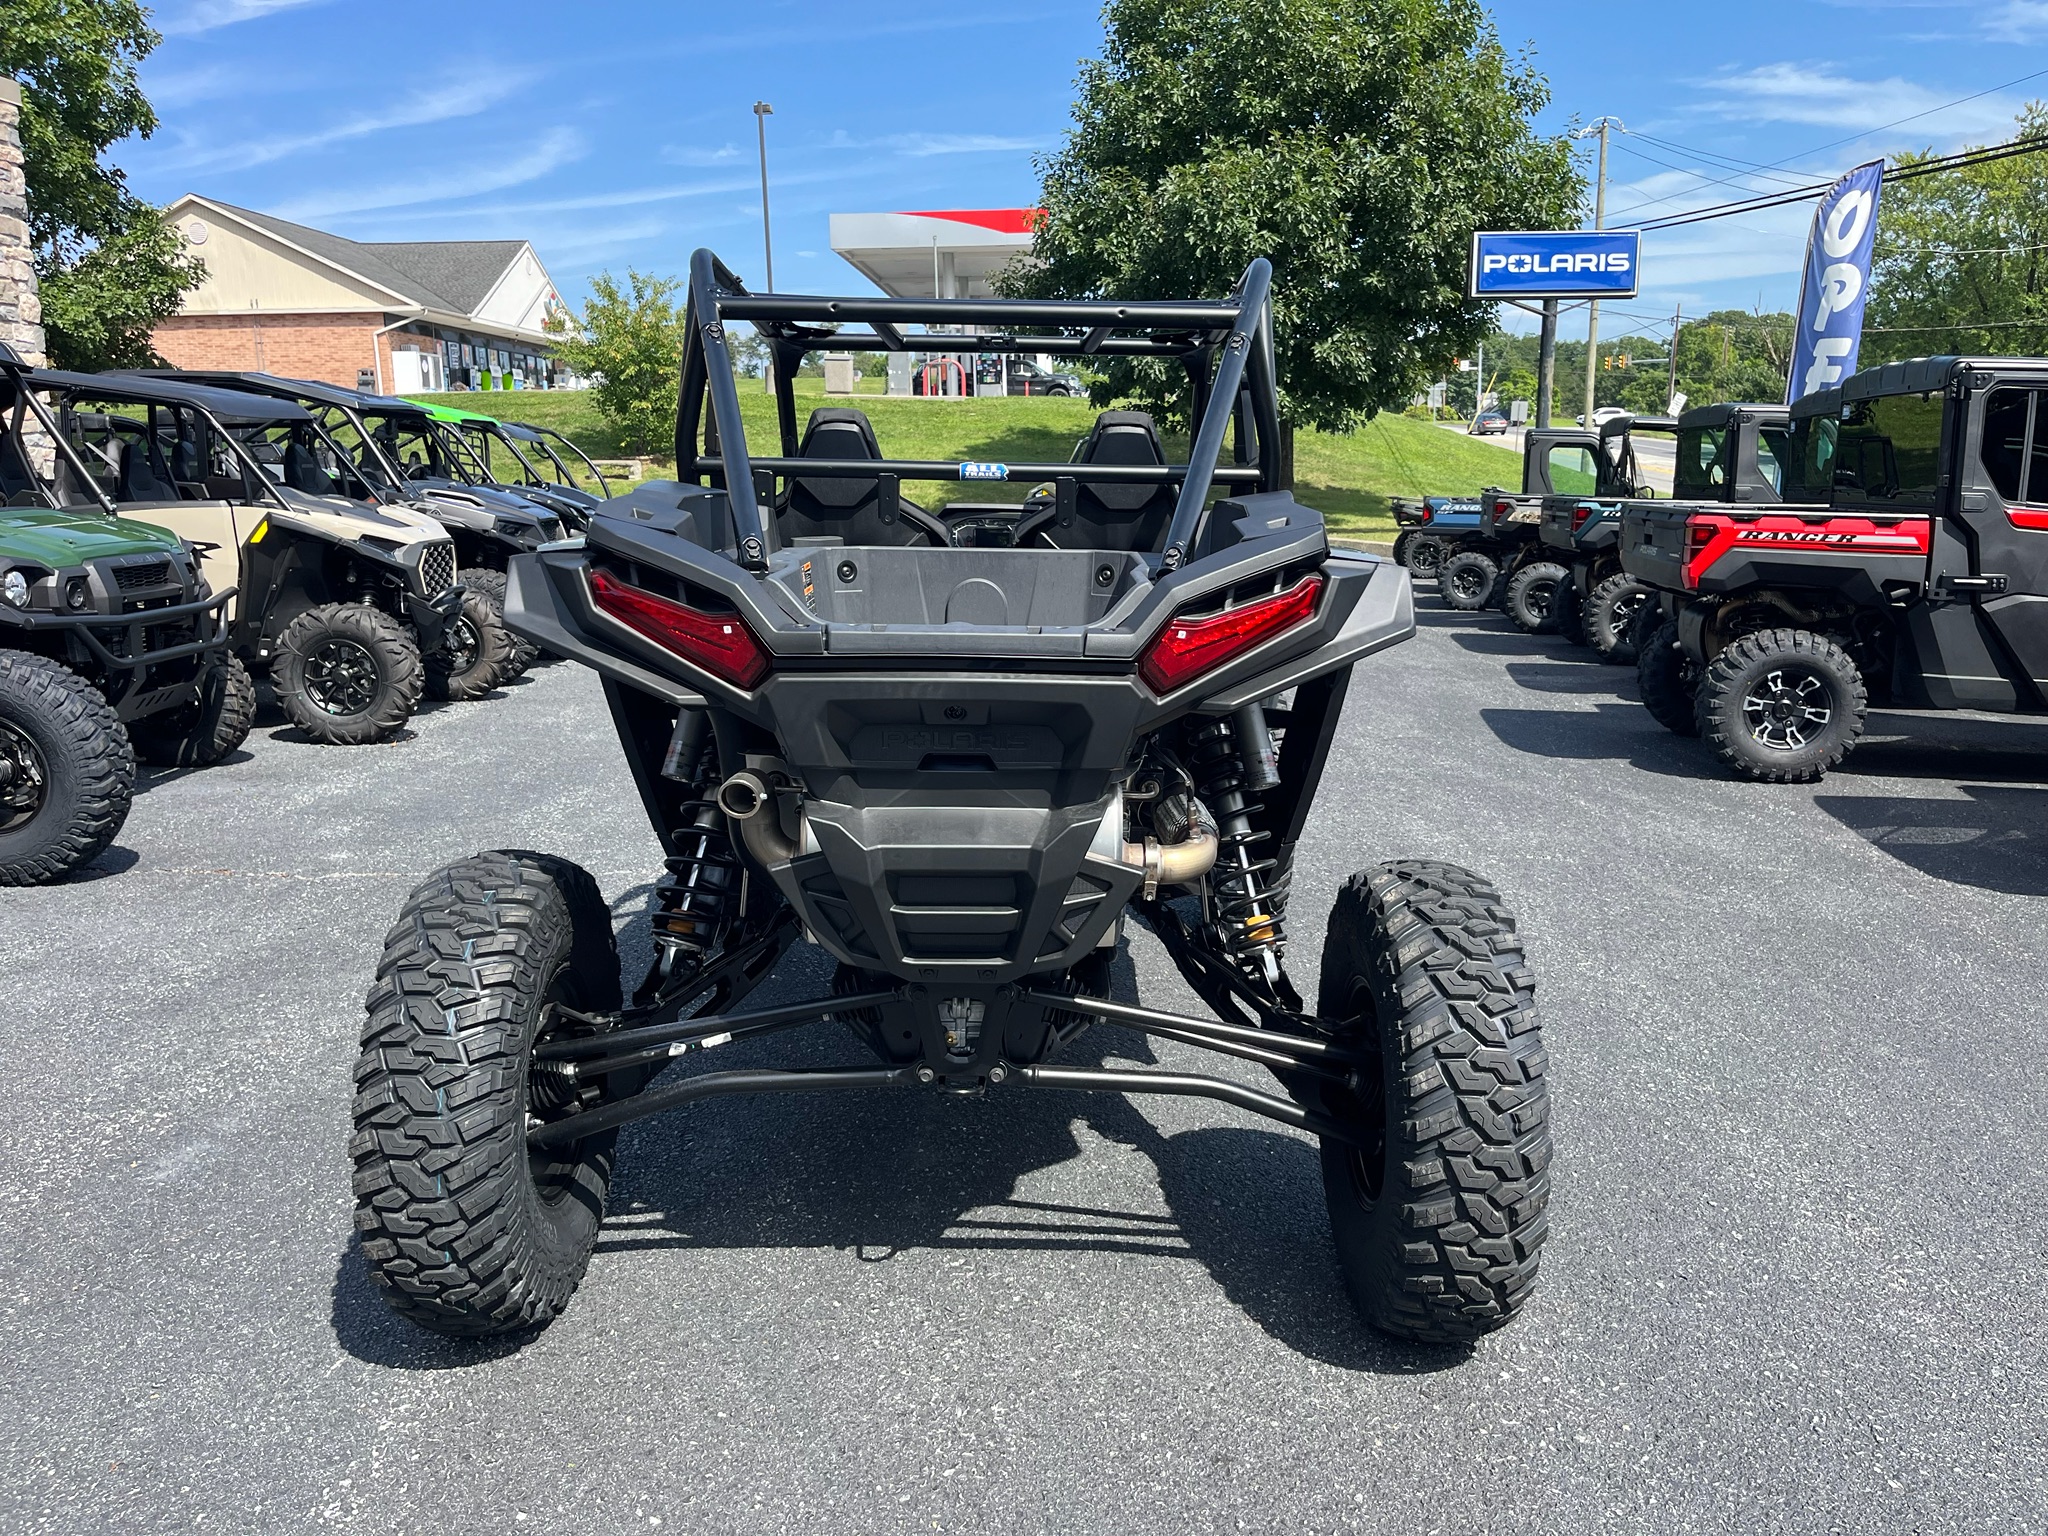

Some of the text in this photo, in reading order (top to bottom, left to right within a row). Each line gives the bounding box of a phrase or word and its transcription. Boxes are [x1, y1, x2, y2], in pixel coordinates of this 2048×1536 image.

[1483, 253, 1630, 273] POLARIS
[1804, 189, 1872, 396] OPE
[965, 464, 1002, 472] ALL
[1742, 530, 1858, 543] RANGER
[881, 730, 1030, 751] POLARIS
